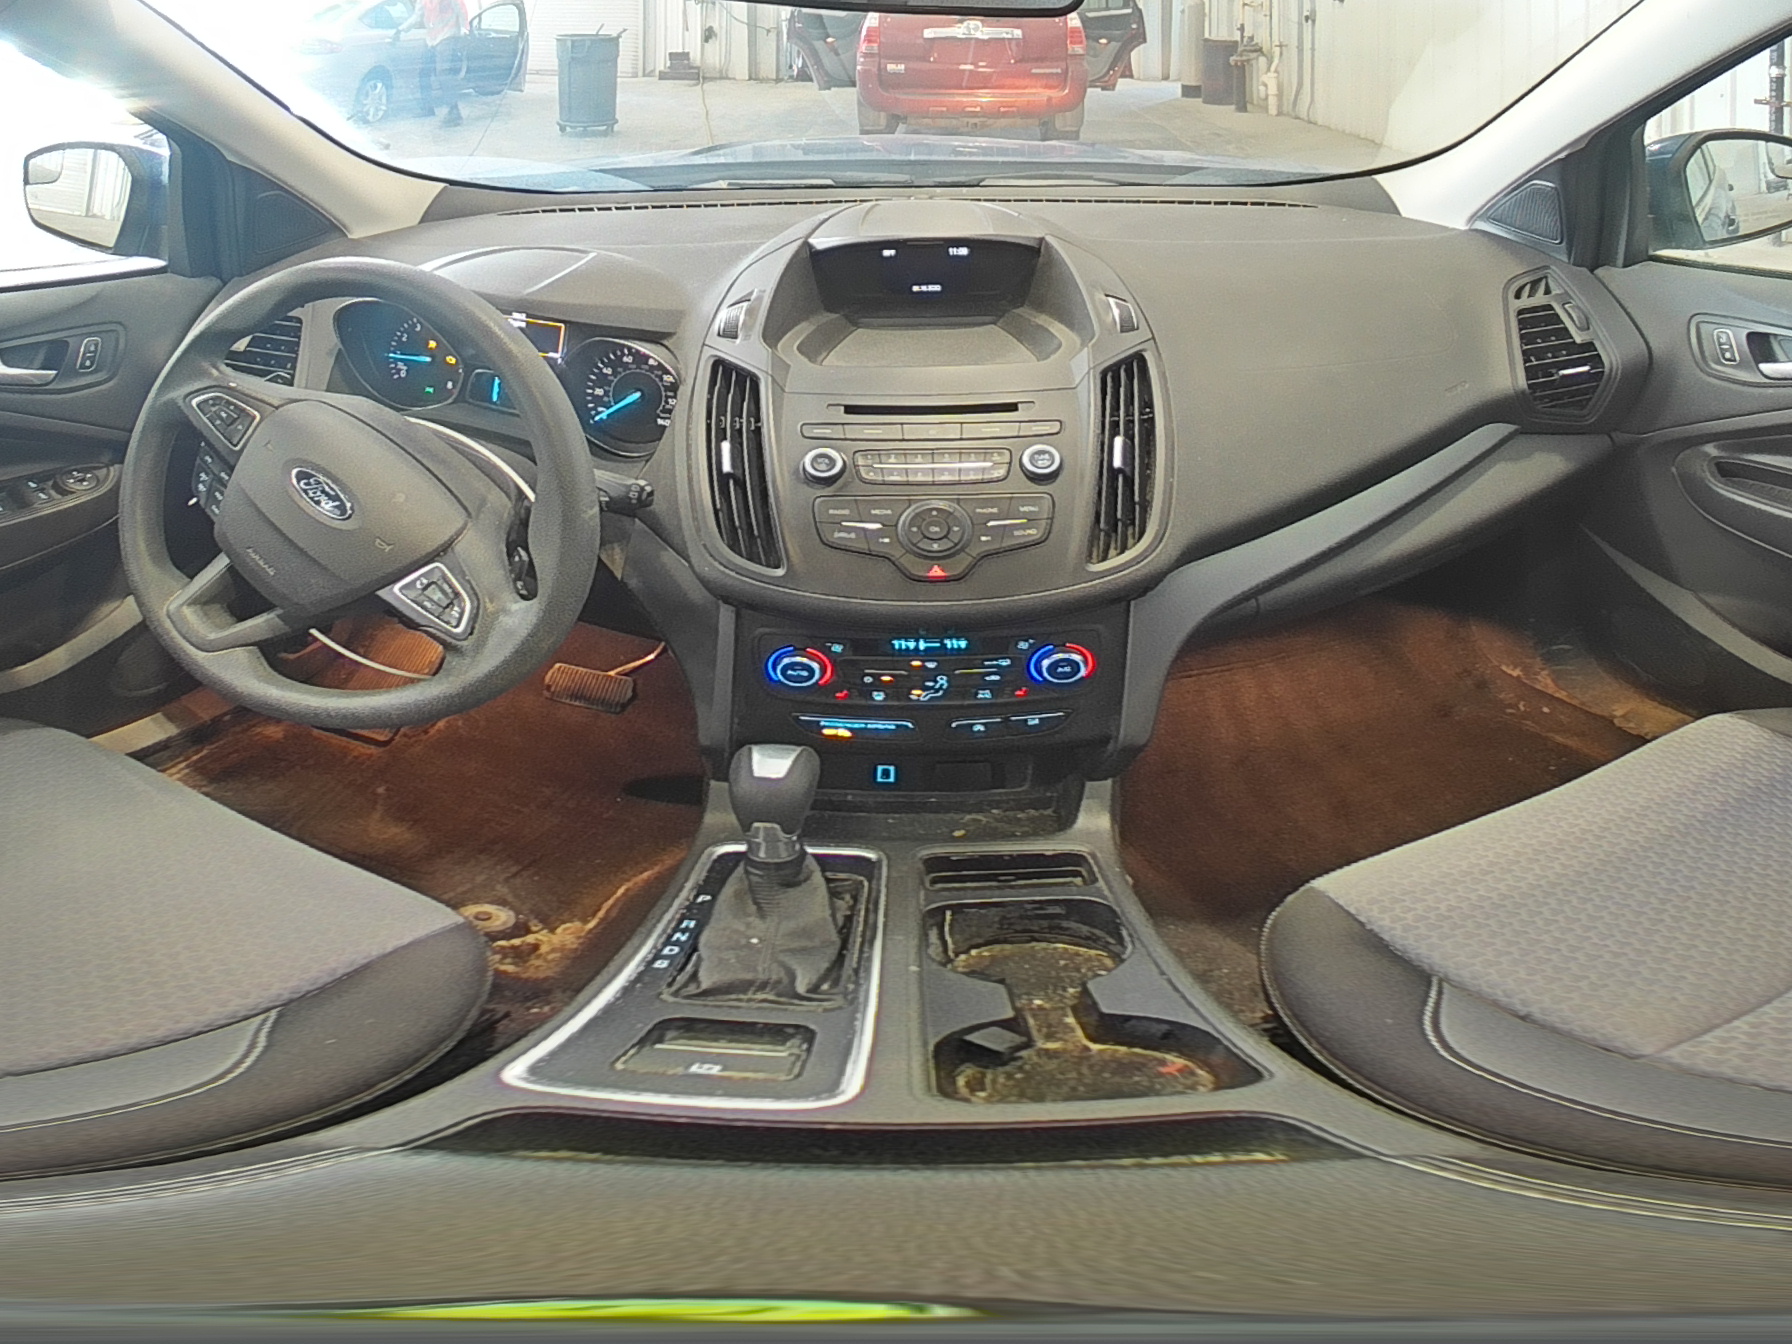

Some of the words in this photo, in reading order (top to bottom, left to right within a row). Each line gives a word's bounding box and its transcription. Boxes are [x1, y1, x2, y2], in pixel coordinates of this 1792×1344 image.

[696, 894, 712, 903] P
[670, 932, 690, 942] N
[661, 945, 680, 955] D
